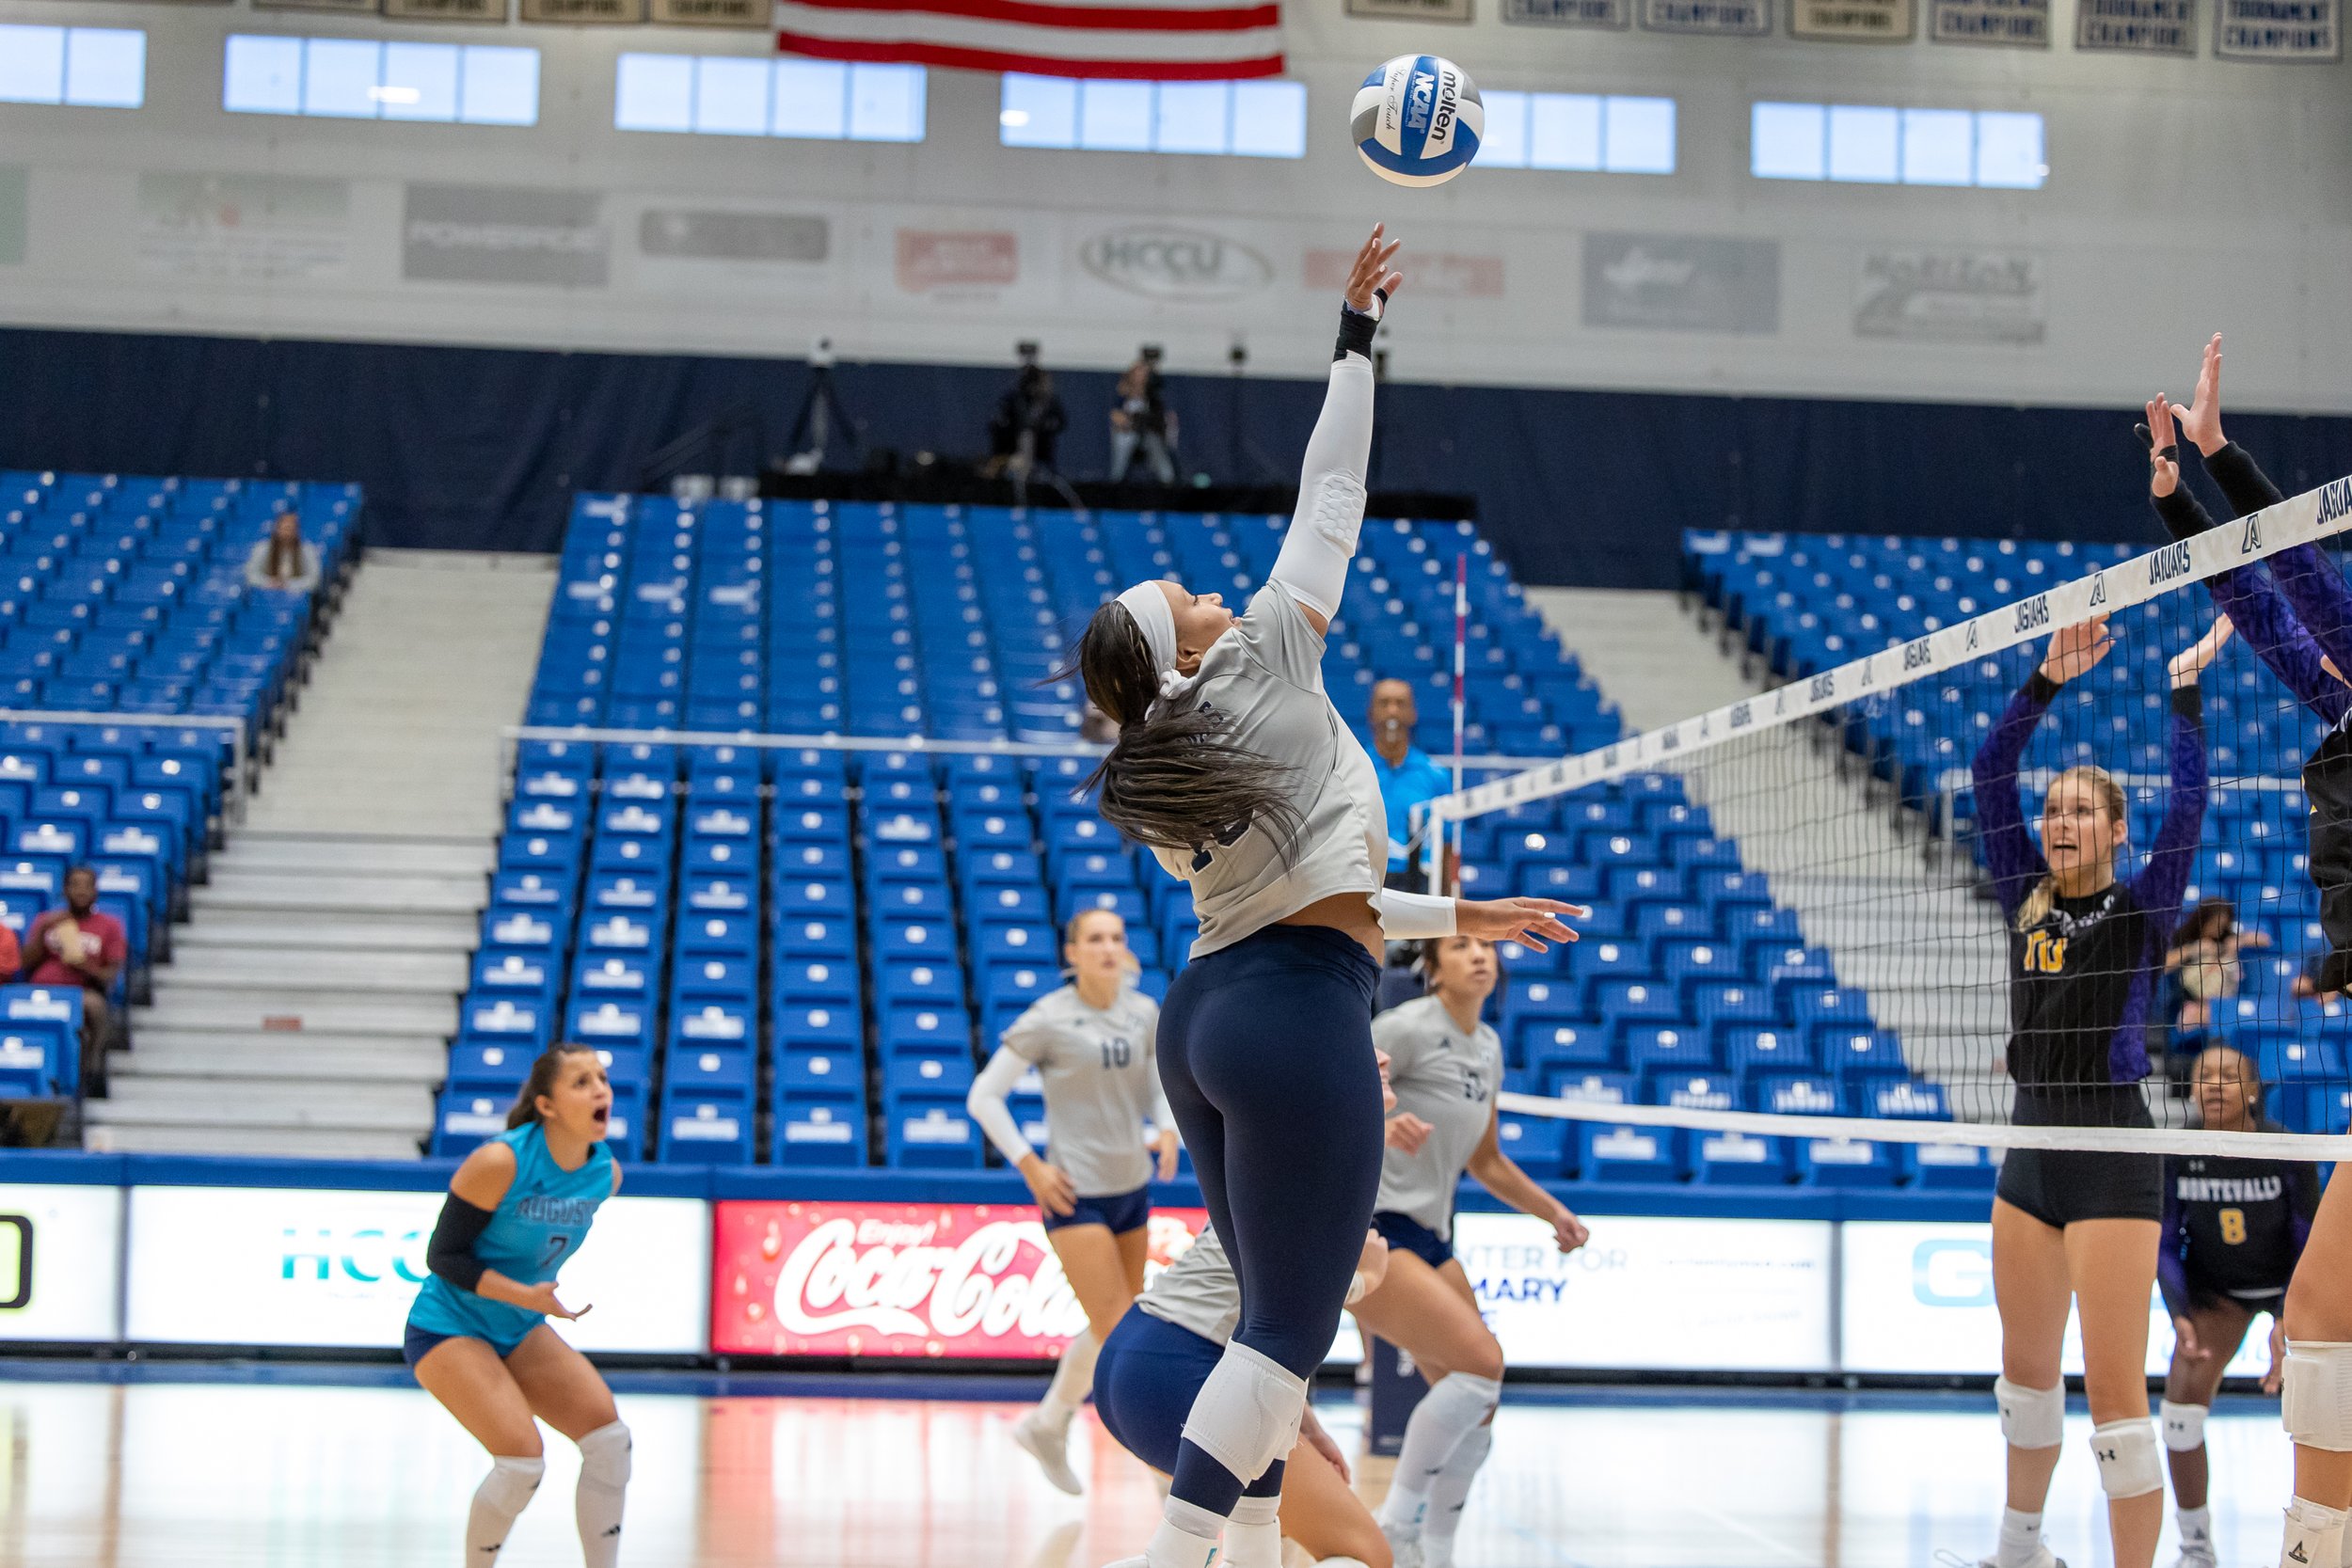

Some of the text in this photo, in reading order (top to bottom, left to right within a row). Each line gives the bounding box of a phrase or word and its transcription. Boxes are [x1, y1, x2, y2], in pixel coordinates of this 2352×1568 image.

[1384, 95, 1398, 132] Touch
[1407, 71, 1436, 130] NCAA
[1431, 71, 1456, 142] molten
[2241, 513, 2262, 554] A
[2316, 476, 2352, 526] JAGUA
[1101, 1037, 1131, 1070] 10
[855, 1219, 938, 1245] Enjoy!
[2217, 1208, 2248, 1246] 8
[539, 1235, 568, 1268] 7
[1470, 1276, 1567, 1304] MARY
